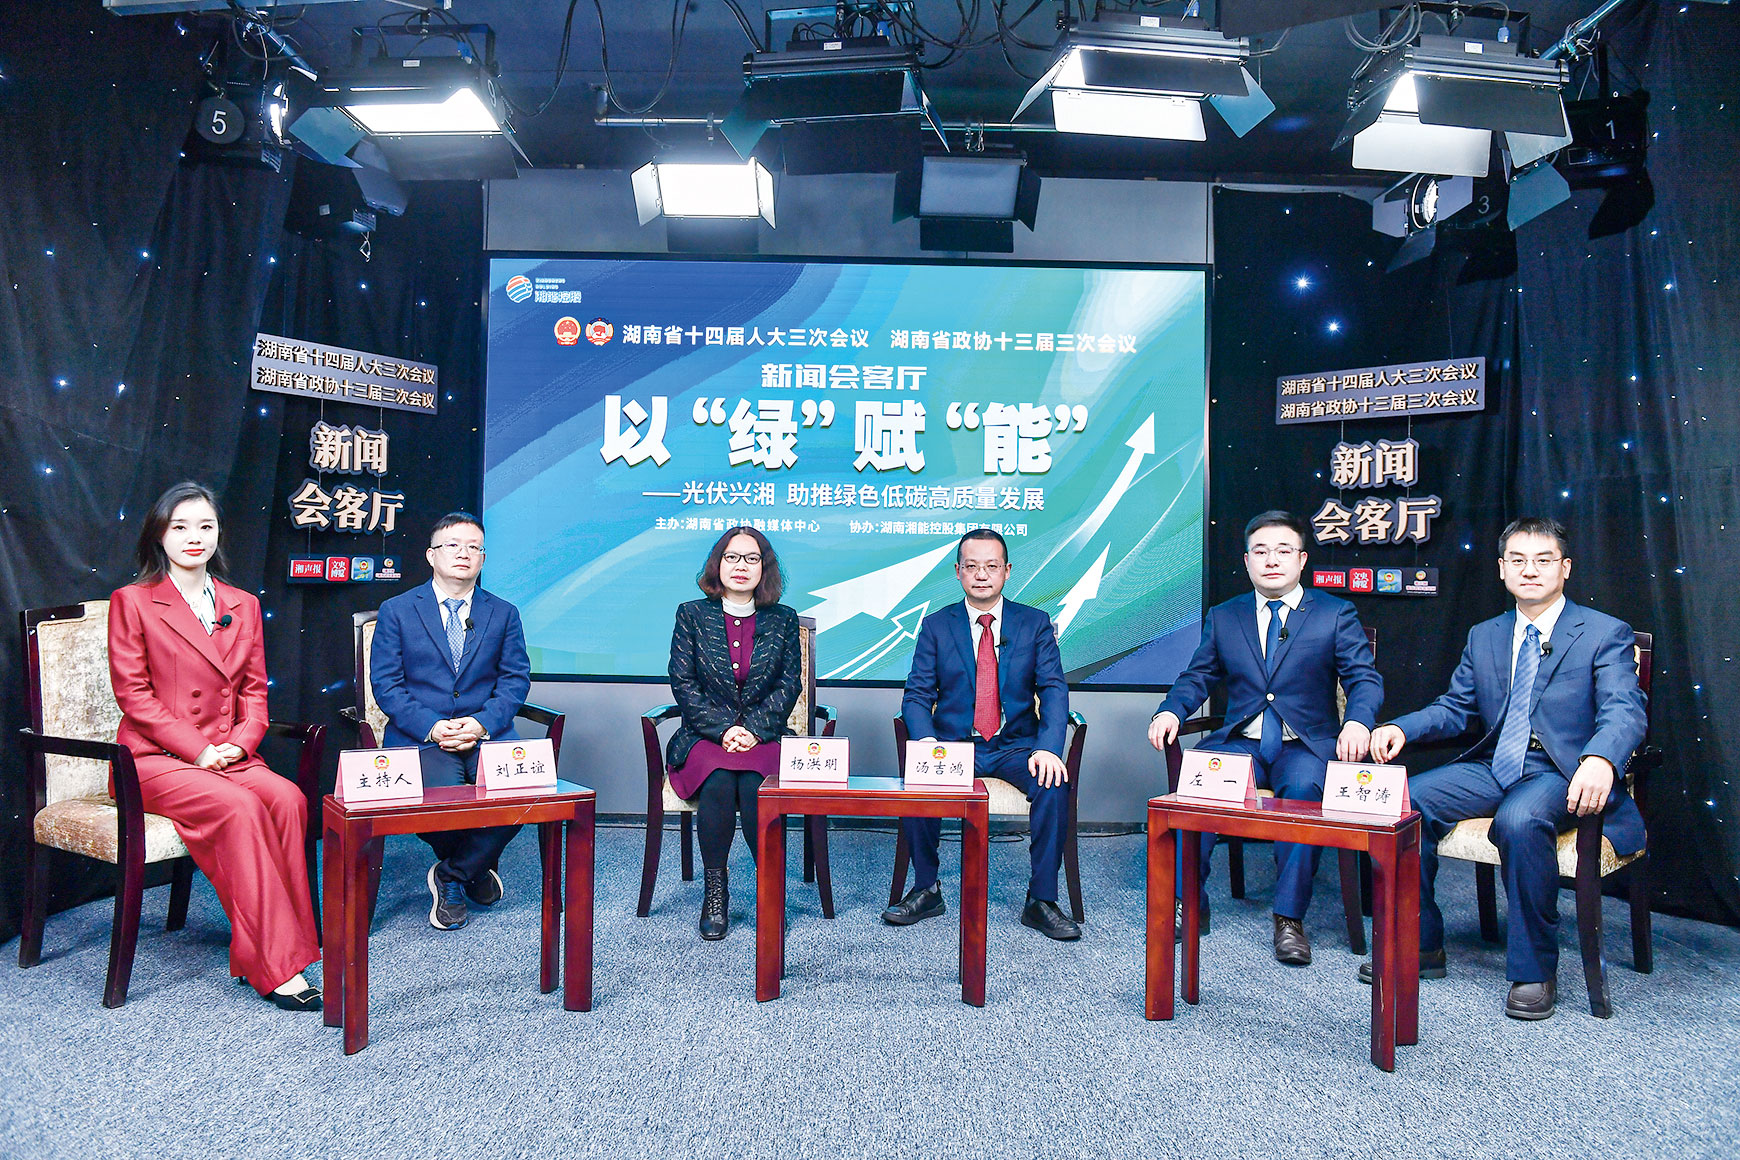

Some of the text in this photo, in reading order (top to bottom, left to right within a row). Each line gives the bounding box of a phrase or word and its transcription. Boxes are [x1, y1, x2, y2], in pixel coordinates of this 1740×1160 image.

[211, 110, 227, 135] 5
[1605, 120, 1615, 140] 1
[1478, 195, 1490, 214] 3
[622, 324, 1137, 354] 湖南省十四届人大三次会议 湖南省政协十三届三次会议
[257, 339, 436, 385] 湖南省十四届人大三次会议
[257, 366, 435, 409] 湖南省政协十三届三次会议
[761, 363, 927, 391] 新闻会客厅
[1281, 362, 1478, 396] 湖南省十四届人大三次会议
[1280, 388, 1478, 419] 湖南省政协十三届三次会议
[313, 424, 389, 474] 新闻
[600, 395, 1089, 475] 以 “绿” 赋 “能”
[1332, 441, 1416, 486] 新闻
[292, 481, 405, 532] 会客厅
[786, 483, 1046, 511] 助推绿色低碳高质量发展
[1312, 498, 1438, 542] 会客厅
[496, 761, 546, 778] 刘正谊
[791, 756, 838, 771] 杨洪明
[915, 761, 964, 776] 汤吉鸿
[356, 773, 412, 788] 主持人
[1335, 785, 1391, 804] 王智涛
